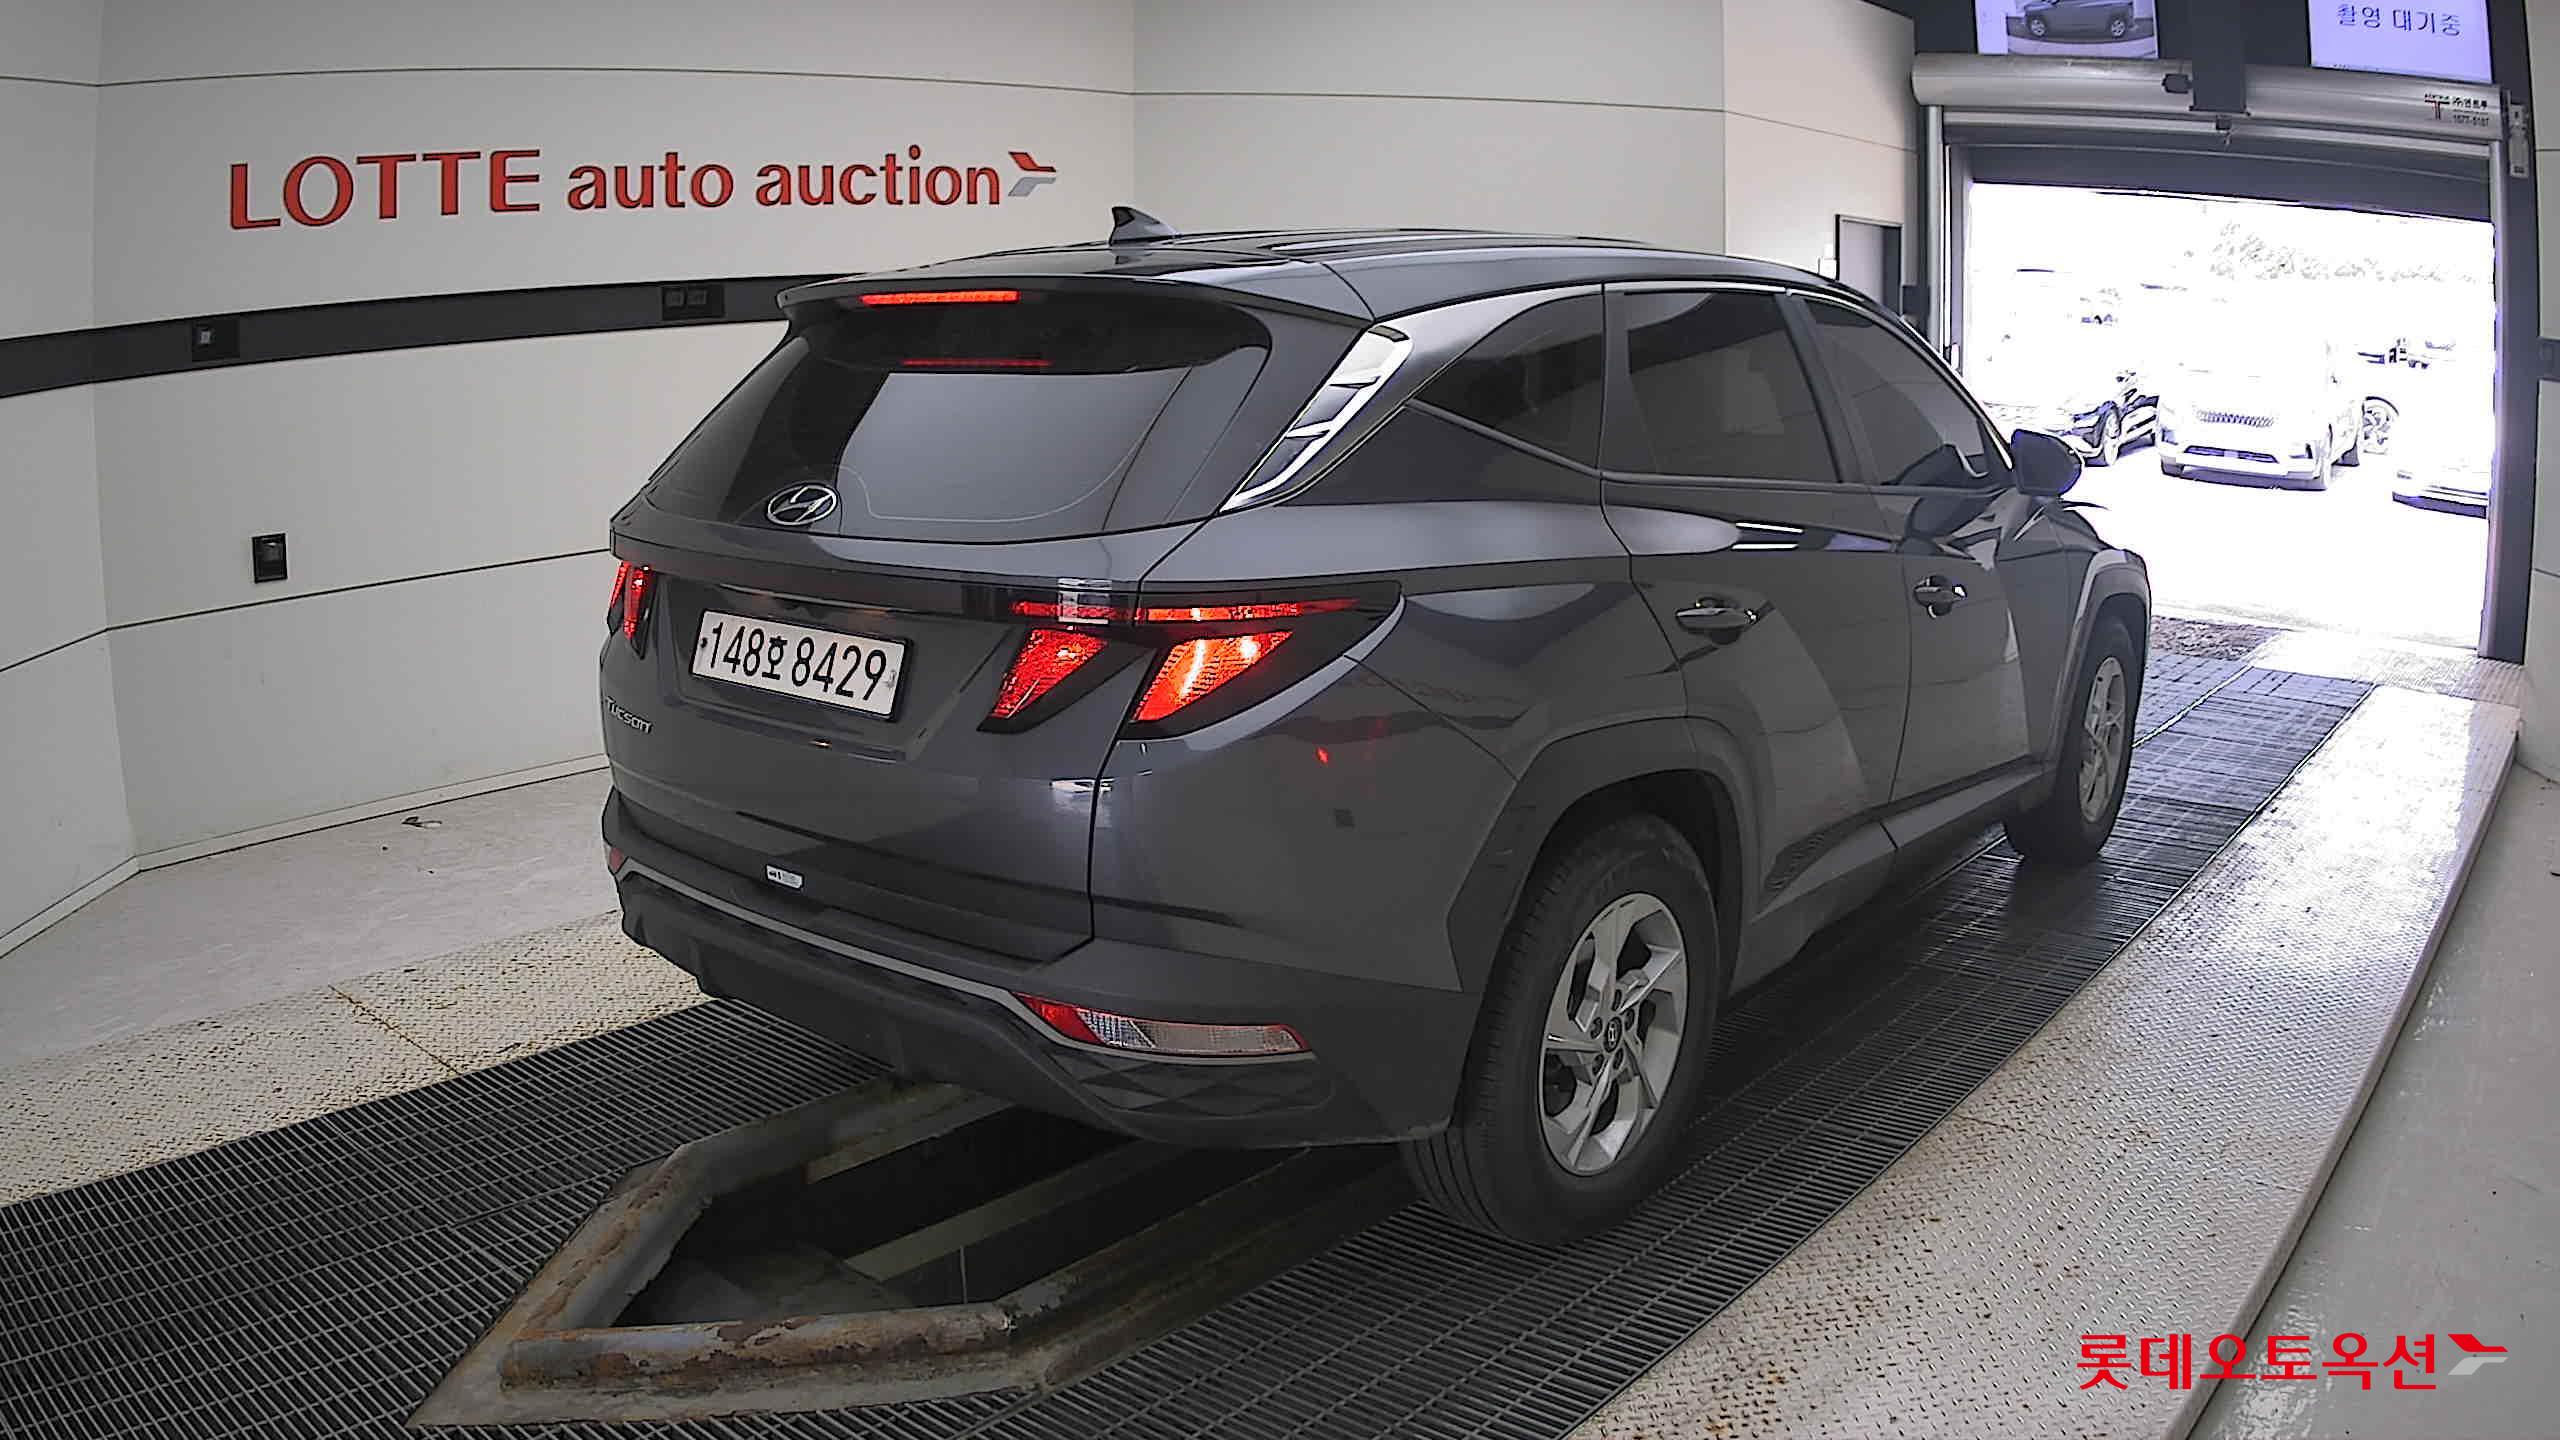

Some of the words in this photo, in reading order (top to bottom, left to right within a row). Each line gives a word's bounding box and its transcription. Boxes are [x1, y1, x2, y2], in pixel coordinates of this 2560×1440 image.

[2337, 4, 2381, 29] 촬영
[2392, 9, 2461, 36] 대기중
[229, 149, 542, 231] LOTTE
[567, 151, 735, 212] auto
[755, 144, 1002, 208] auction
[710, 621, 787, 680] 148호
[791, 637, 887, 701] 8429
